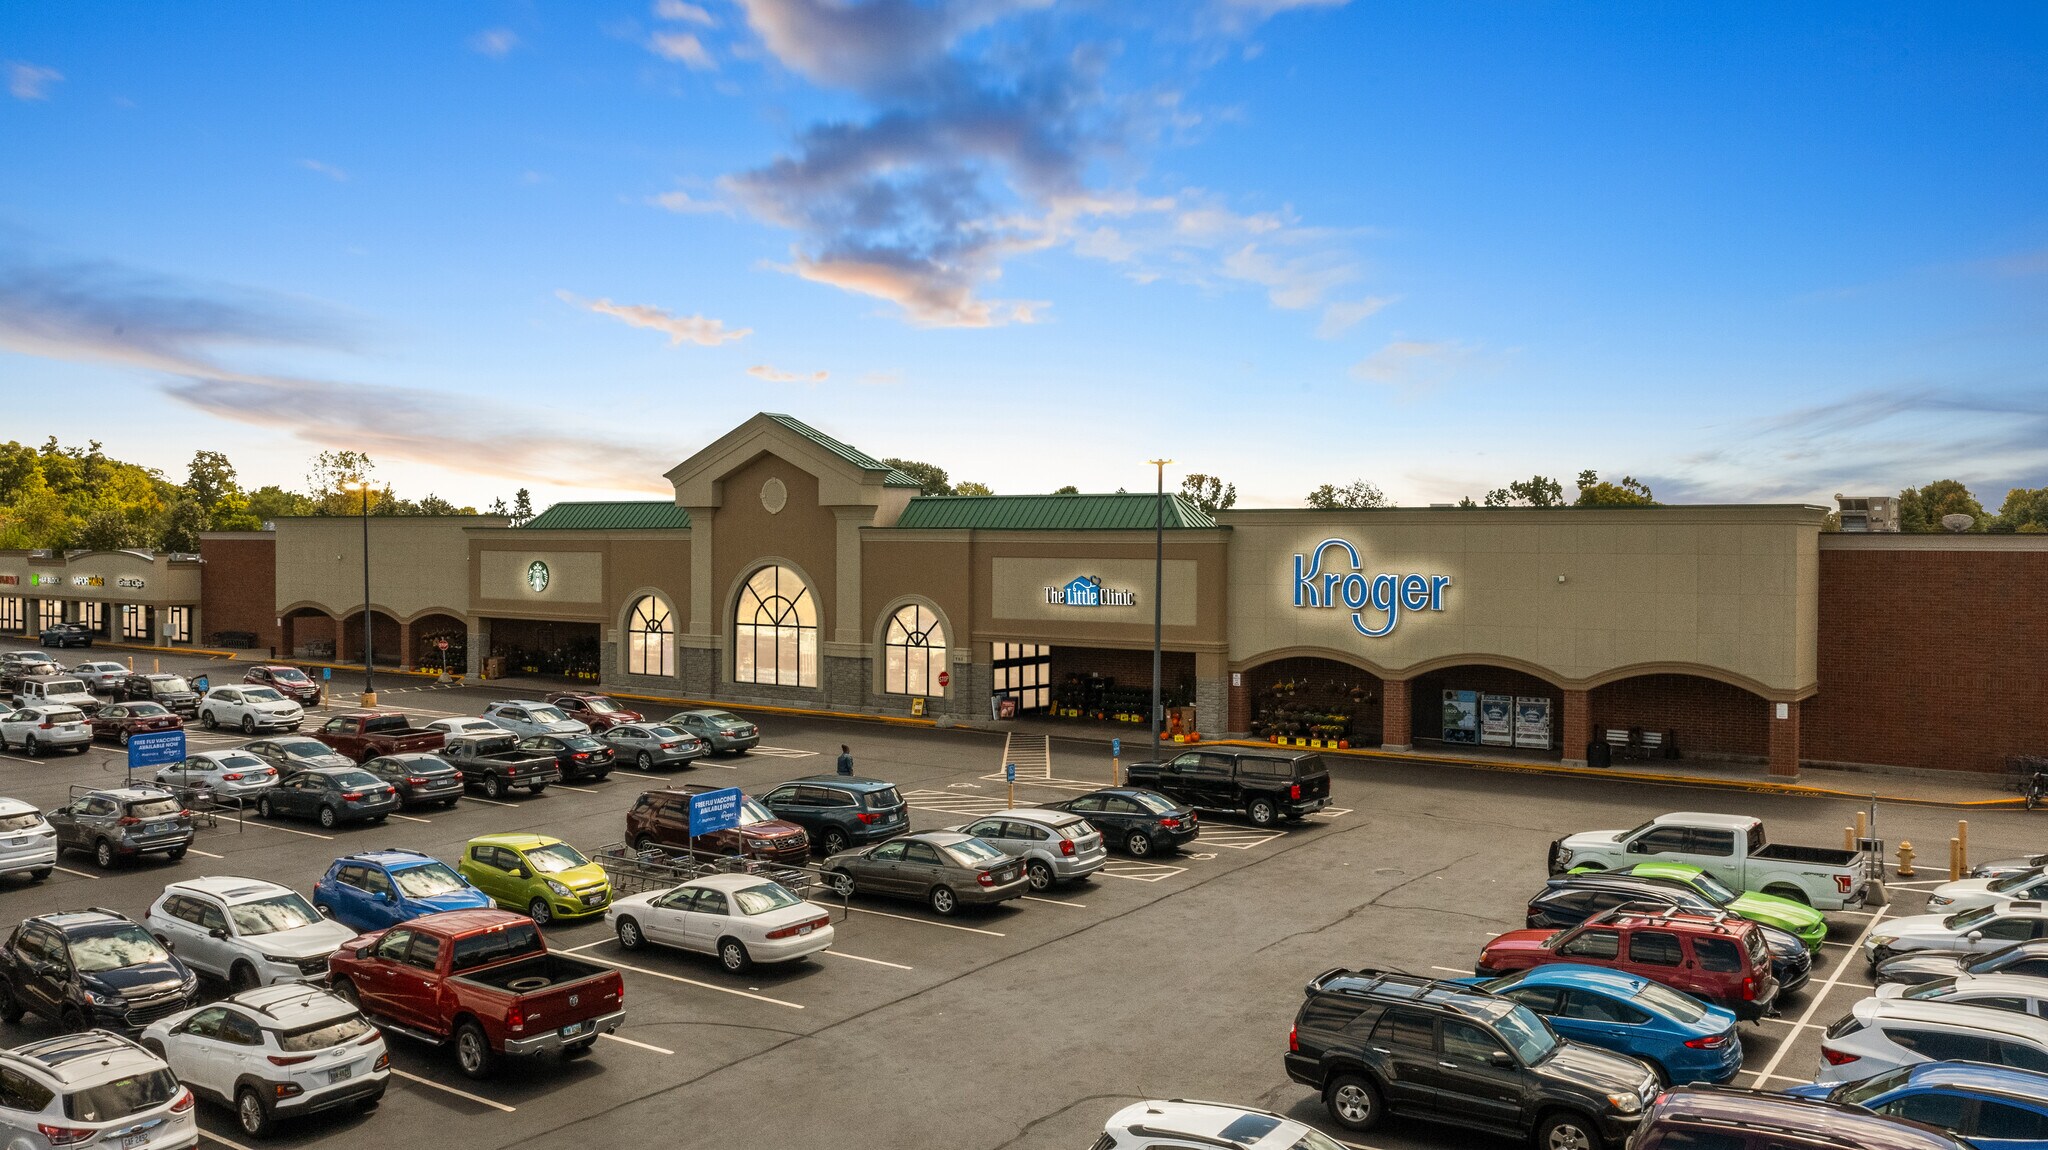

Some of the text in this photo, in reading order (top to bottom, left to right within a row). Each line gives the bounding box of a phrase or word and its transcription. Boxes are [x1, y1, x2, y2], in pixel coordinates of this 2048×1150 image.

[1293, 538, 1451, 637] Kroger
[1044, 586, 1135, 606] The Little Clinic
[714, 795, 736, 804] VACCINES
[700, 805, 722, 814] AVAILABLE
